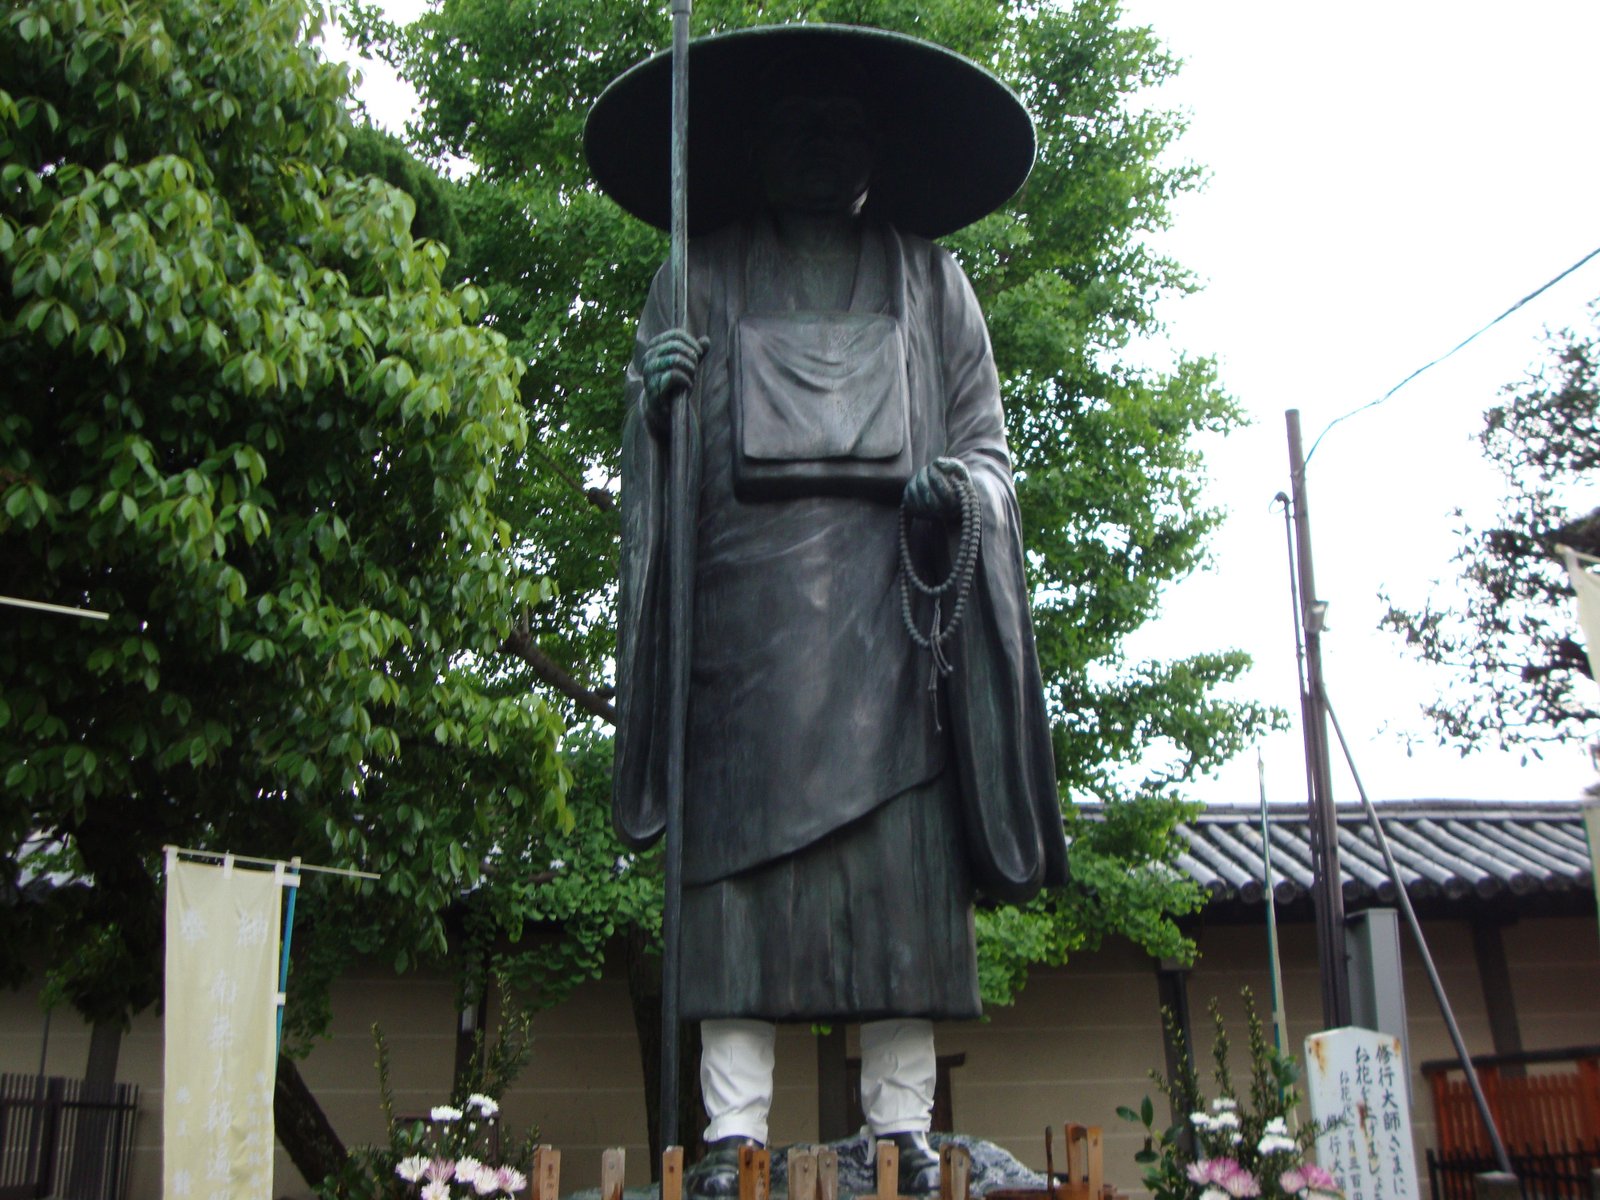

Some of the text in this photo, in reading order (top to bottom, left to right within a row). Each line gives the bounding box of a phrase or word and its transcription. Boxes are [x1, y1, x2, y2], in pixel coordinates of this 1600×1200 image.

[1376, 1044, 1407, 1195] 修行大師さまに
